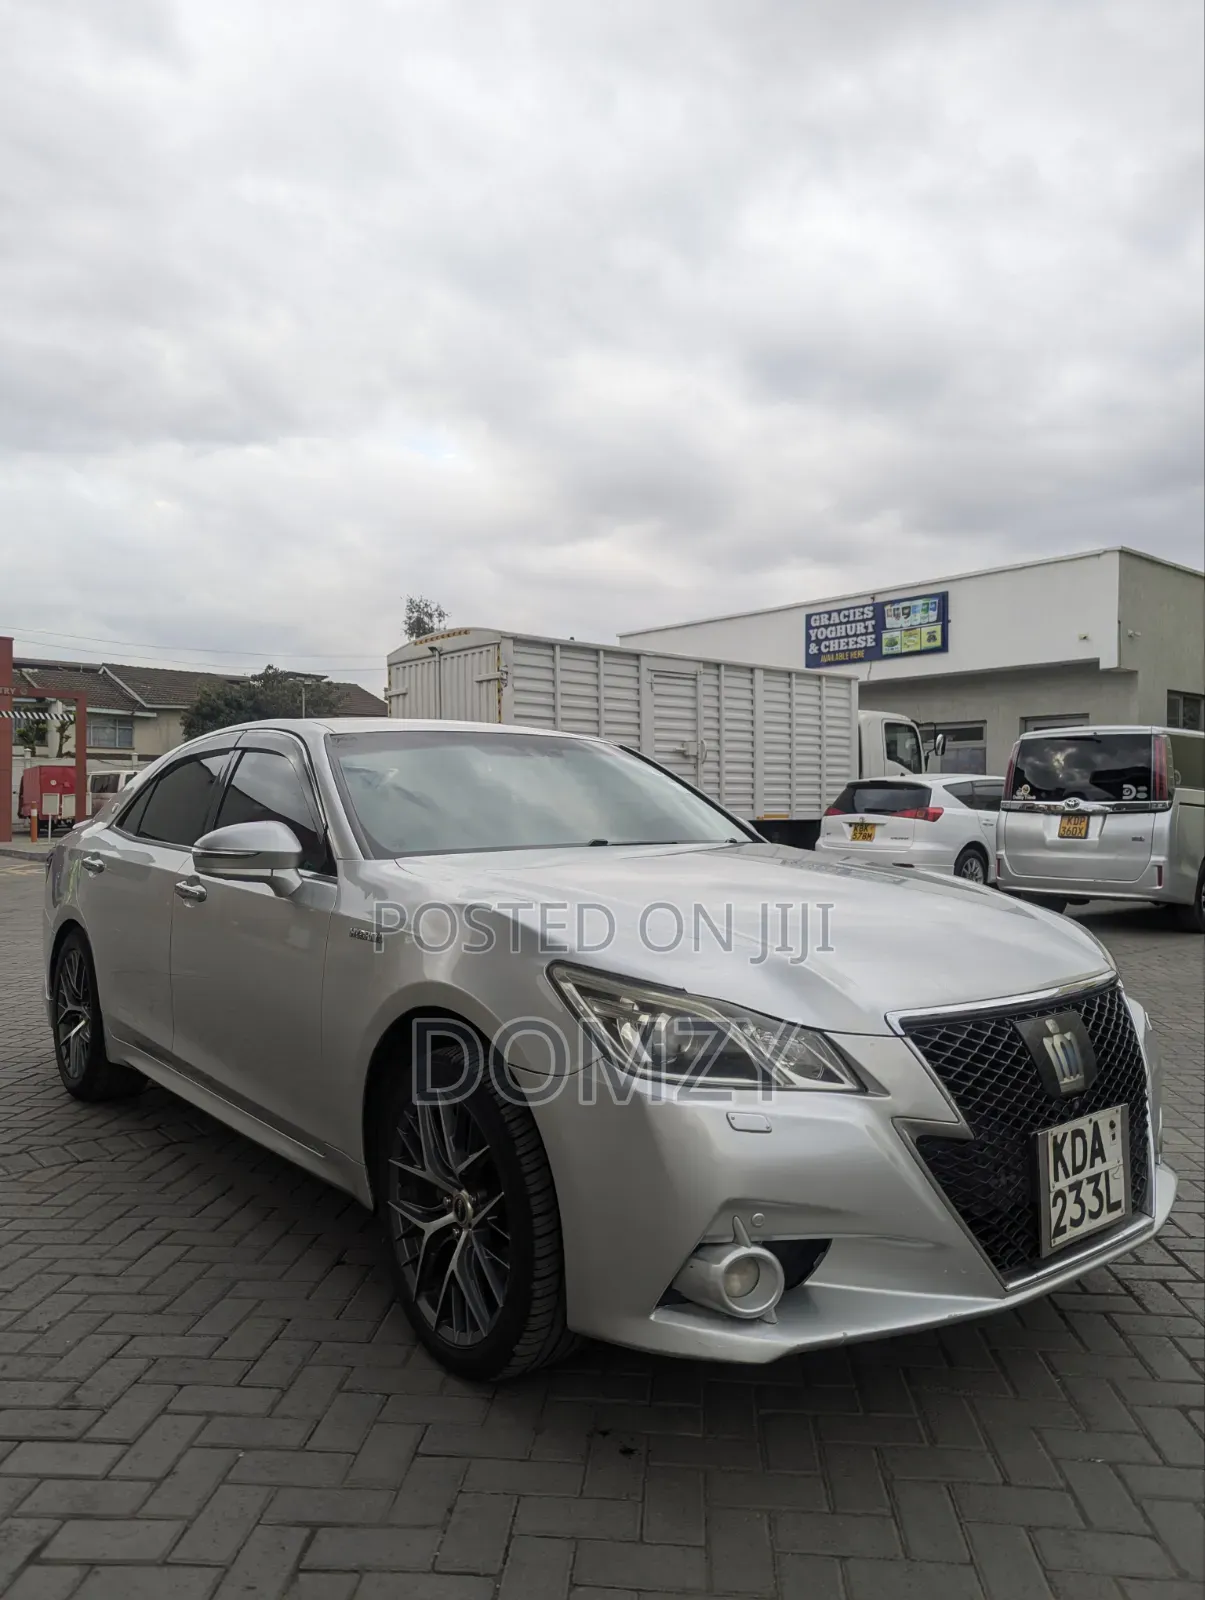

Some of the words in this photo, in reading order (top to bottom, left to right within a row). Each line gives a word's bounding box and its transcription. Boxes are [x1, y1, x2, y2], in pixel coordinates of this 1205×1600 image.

[811, 606, 874, 627] GRACIES
[809, 620, 876, 641] YOGHURT
[809, 643, 819, 654] &
[821, 634, 876, 653] CHEESE
[821, 651, 849, 663] AVAILABLE
[850, 649, 865, 660] HERE
[1052, 1120, 1107, 1183] KDA
[1052, 1170, 1122, 1239] 233L
